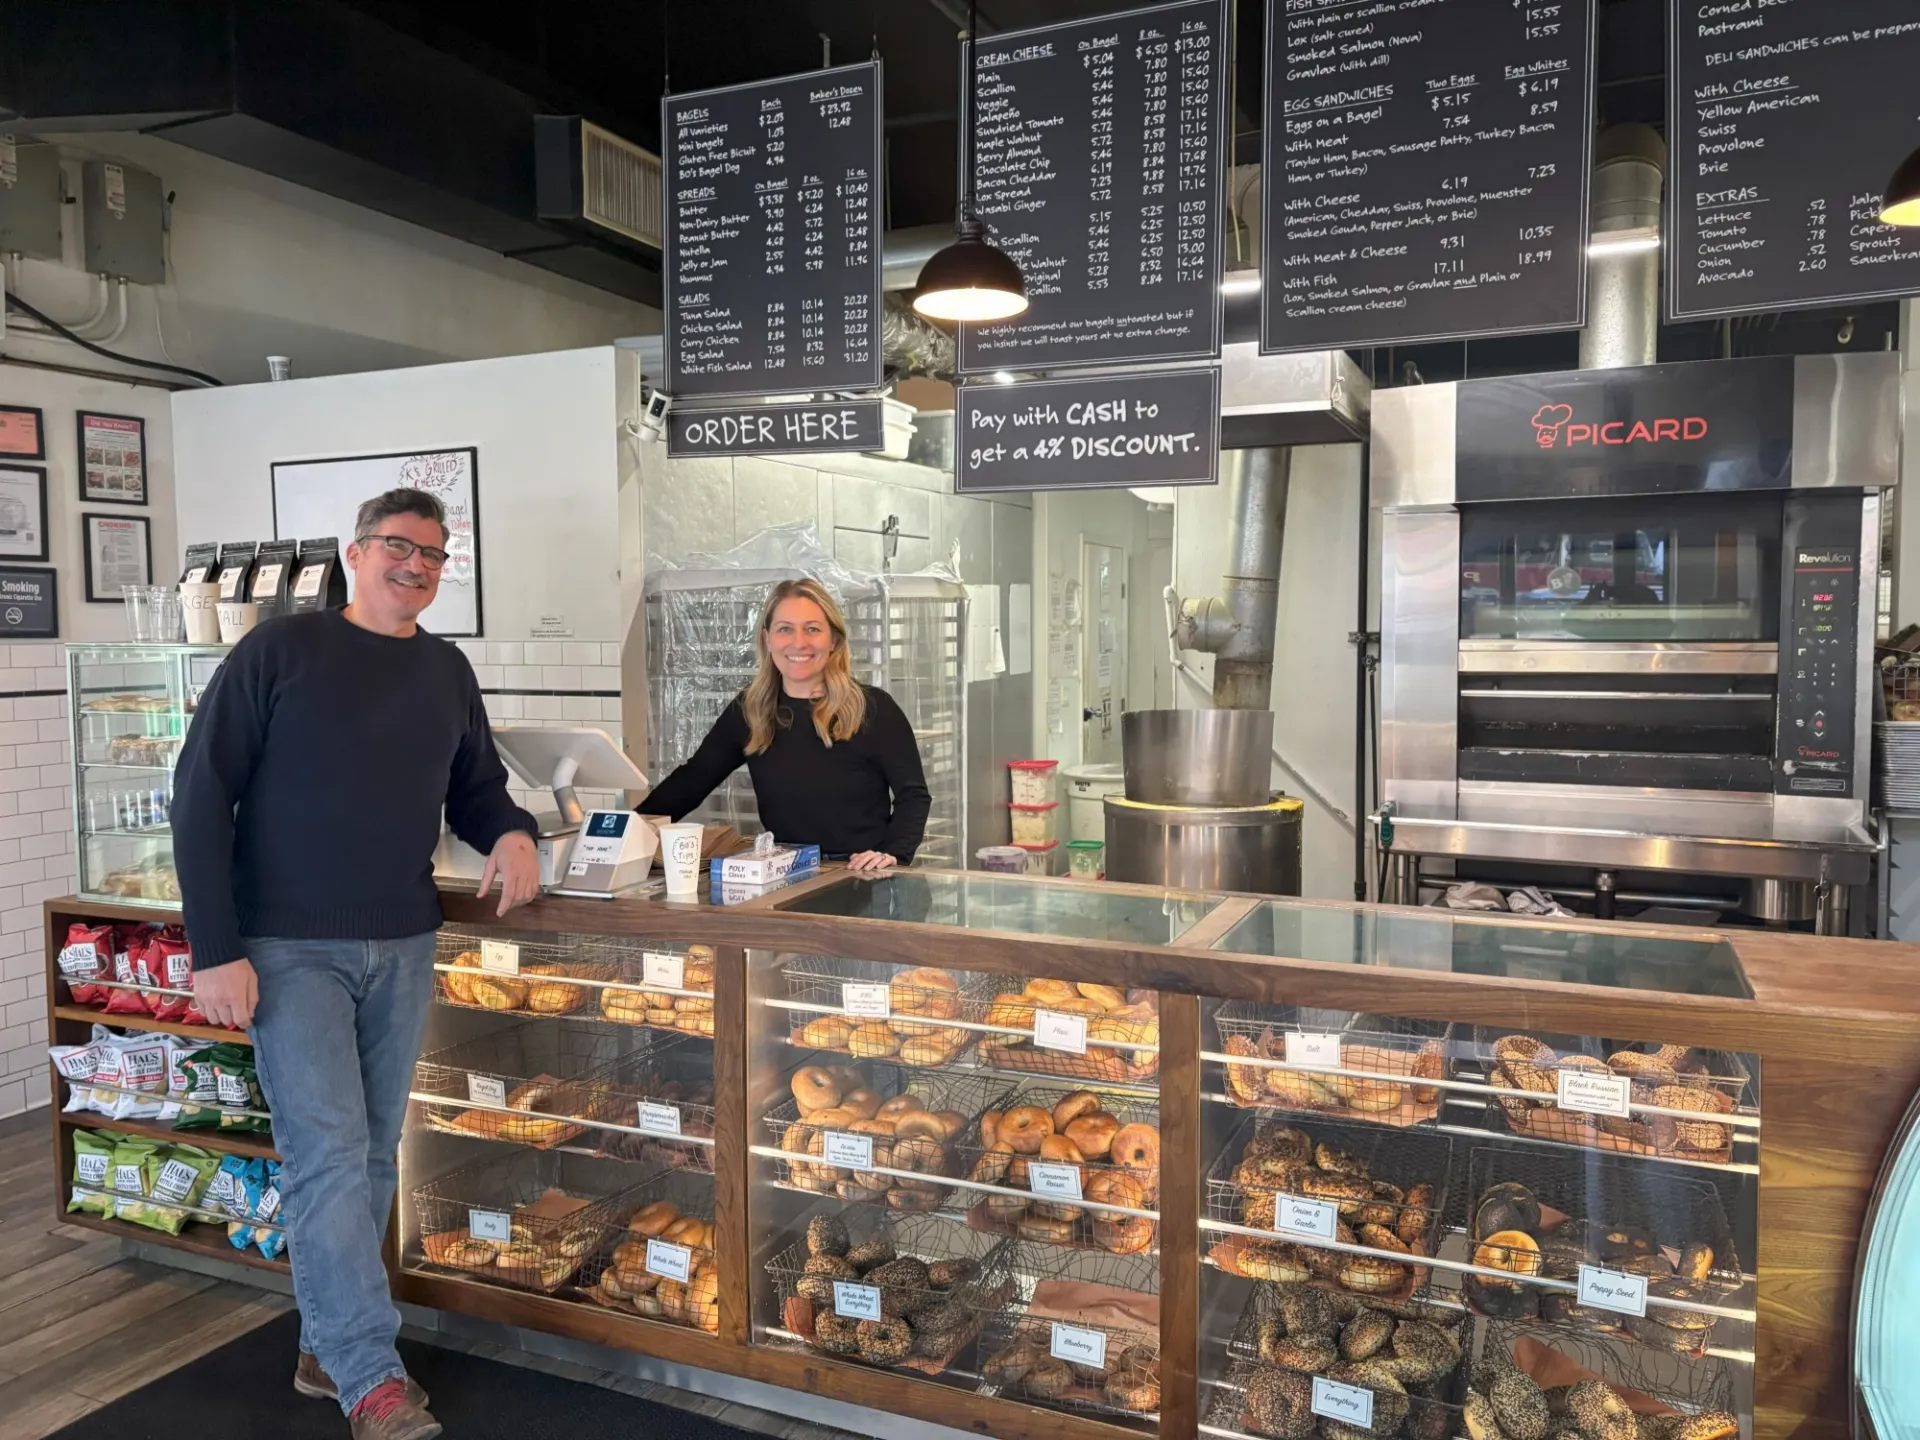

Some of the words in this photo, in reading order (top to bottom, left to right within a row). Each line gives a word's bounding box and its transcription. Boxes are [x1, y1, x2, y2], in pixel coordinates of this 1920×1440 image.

[1527, 6, 1561, 21] 15.55
[1698, 13, 1763, 37] Pastrami
[1288, 37, 1307, 47] Lox
[1311, 30, 1335, 43] (salt
[1338, 23, 1373, 38] cured)
[1287, 46, 1335, 63] Smoked
[1340, 40, 1384, 54] Salmon
[1389, 31, 1422, 46] (Nova)
[1706, 52, 1732, 66] DELI
[1736, 38, 1818, 60] SANDWICHES
[1823, 35, 1848, 44] can
[1852, 31, 1870, 40] be
[976, 53, 1012, 69] CREAM
[1012, 43, 1053, 61] CHEESE
[978, 72, 1000, 84] Plain
[1287, 64, 1336, 80] Gravlax
[810, 90, 838, 101] Baker's
[840, 86, 863, 97] Dozen
[1284, 98, 1310, 112] EGG
[1314, 84, 1394, 107] SANDWICHES
[677, 109, 709, 122] BAGELS
[761, 98, 781, 108] Each
[976, 105, 1020, 127] Jalapeño
[1698, 104, 1742, 121] Yellow
[1747, 95, 1819, 114] American
[1286, 121, 1312, 134] Eggs
[1316, 119, 1329, 127] on
[1347, 106, 1382, 123] Bagel
[1389, 140, 1436, 153] Sausage
[1441, 135, 1472, 146] Patty,
[1475, 128, 1515, 140] Turkey
[1520, 123, 1554, 134] Bacon
[1699, 138, 1764, 155] Provolone
[679, 155, 706, 165] Gluten
[709, 152, 728, 160] Free
[731, 146, 756, 158] Bicuit
[767, 141, 784, 151] 5.20
[977, 179, 1006, 189] Bacon
[1010, 172, 1056, 185] Cheddar
[1091, 162, 1112, 173] 6.19
[1143, 156, 1164, 167] 8.84
[1180, 150, 1206, 163] 17.68
[1699, 161, 1728, 175] Brie
[976, 193, 992, 201] Lox
[994, 187, 1031, 201] Spread
[1091, 175, 1111, 187] 7.23
[1143, 169, 1164, 181] 9.88
[1180, 164, 1206, 177] 19.76
[677, 187, 715, 200] SPREADS
[1696, 187, 1758, 206] EXTRAS
[1285, 213, 1337, 226] (American,
[1341, 206, 1390, 219] Cheddar,
[1426, 194, 1477, 207] Provolone,
[1480, 187, 1532, 200] Muenster
[1698, 212, 1751, 225] Lettuce
[1808, 199, 1826, 211] .52
[1850, 236, 1900, 252] Sprouts
[1698, 259, 1731, 268] Onion
[1698, 269, 1753, 284] Avocado
[1799, 259, 1826, 271] 2.60
[680, 274, 712, 283] Hummus
[679, 293, 710, 304] SALADS
[992, 325, 1016, 337] highly
[1018, 321, 1067, 332] recommend
[1085, 316, 1114, 329] bagels
[1116, 314, 1164, 325] untoasted
[1166, 311, 1183, 320] but
[1186, 309, 1193, 318] if
[978, 343, 992, 351] you
[1035, 335, 1047, 344] will
[1050, 334, 1073, 343] toast
[1075, 334, 1097, 343] yours
[1100, 331, 1111, 339] at
[1126, 329, 1152, 337] extra
[1155, 326, 1190, 336] charge.
[707, 363, 723, 372] Fish
[726, 361, 752, 371] Salad
[765, 359, 785, 368] 12.48
[803, 356, 824, 366] 15.60
[844, 352, 868, 362] 31.20
[972, 410, 1006, 433] Pay
[1013, 405, 1059, 426] with
[1067, 399, 1126, 425] CASH
[1135, 400, 1158, 419] to
[686, 416, 775, 445] ORDER
[784, 411, 858, 442] HERE
[1566, 416, 1708, 447] PICARD
[970, 443, 1006, 469] get
[1013, 448, 1028, 459] a
[1034, 436, 1065, 458] 4%
[1071, 433, 1199, 459] DISCOUNT.
[425, 459, 457, 477] GRILLED
[414, 474, 447, 489] CHEESE
[1799, 551, 1851, 564] Revolution
[2, 580, 40, 595] Smoking
[776, 866, 791, 875] POLY
[68, 1052, 99, 1070] HAL'S
[127, 1052, 159, 1064] HAL'S
[147, 1066, 162, 1074] CHIPS
[1568, 1079, 1589, 1089] Black
[1591, 1083, 1619, 1093] Russian
[80, 1158, 106, 1169] HAL'S
[166, 1163, 193, 1181] HAL'S
[116, 1167, 136, 1179] HAL'S
[1039, 1172, 1070, 1181] Cinnamon
[159, 1177, 174, 1187] KETTLE
[1046, 1180, 1065, 1188] Raisin
[1292, 1206, 1312, 1216] Onion
[1295, 1218, 1317, 1229] Garlic
[858, 1293, 874, 1302] Wheat
[1590, 1282, 1613, 1298] Poppy
[1616, 1287, 1635, 1299] Seed
[845, 1298, 871, 1311] Everything
[1064, 1338, 1093, 1353] Blueberry
[1324, 1393, 1359, 1410] Everything
